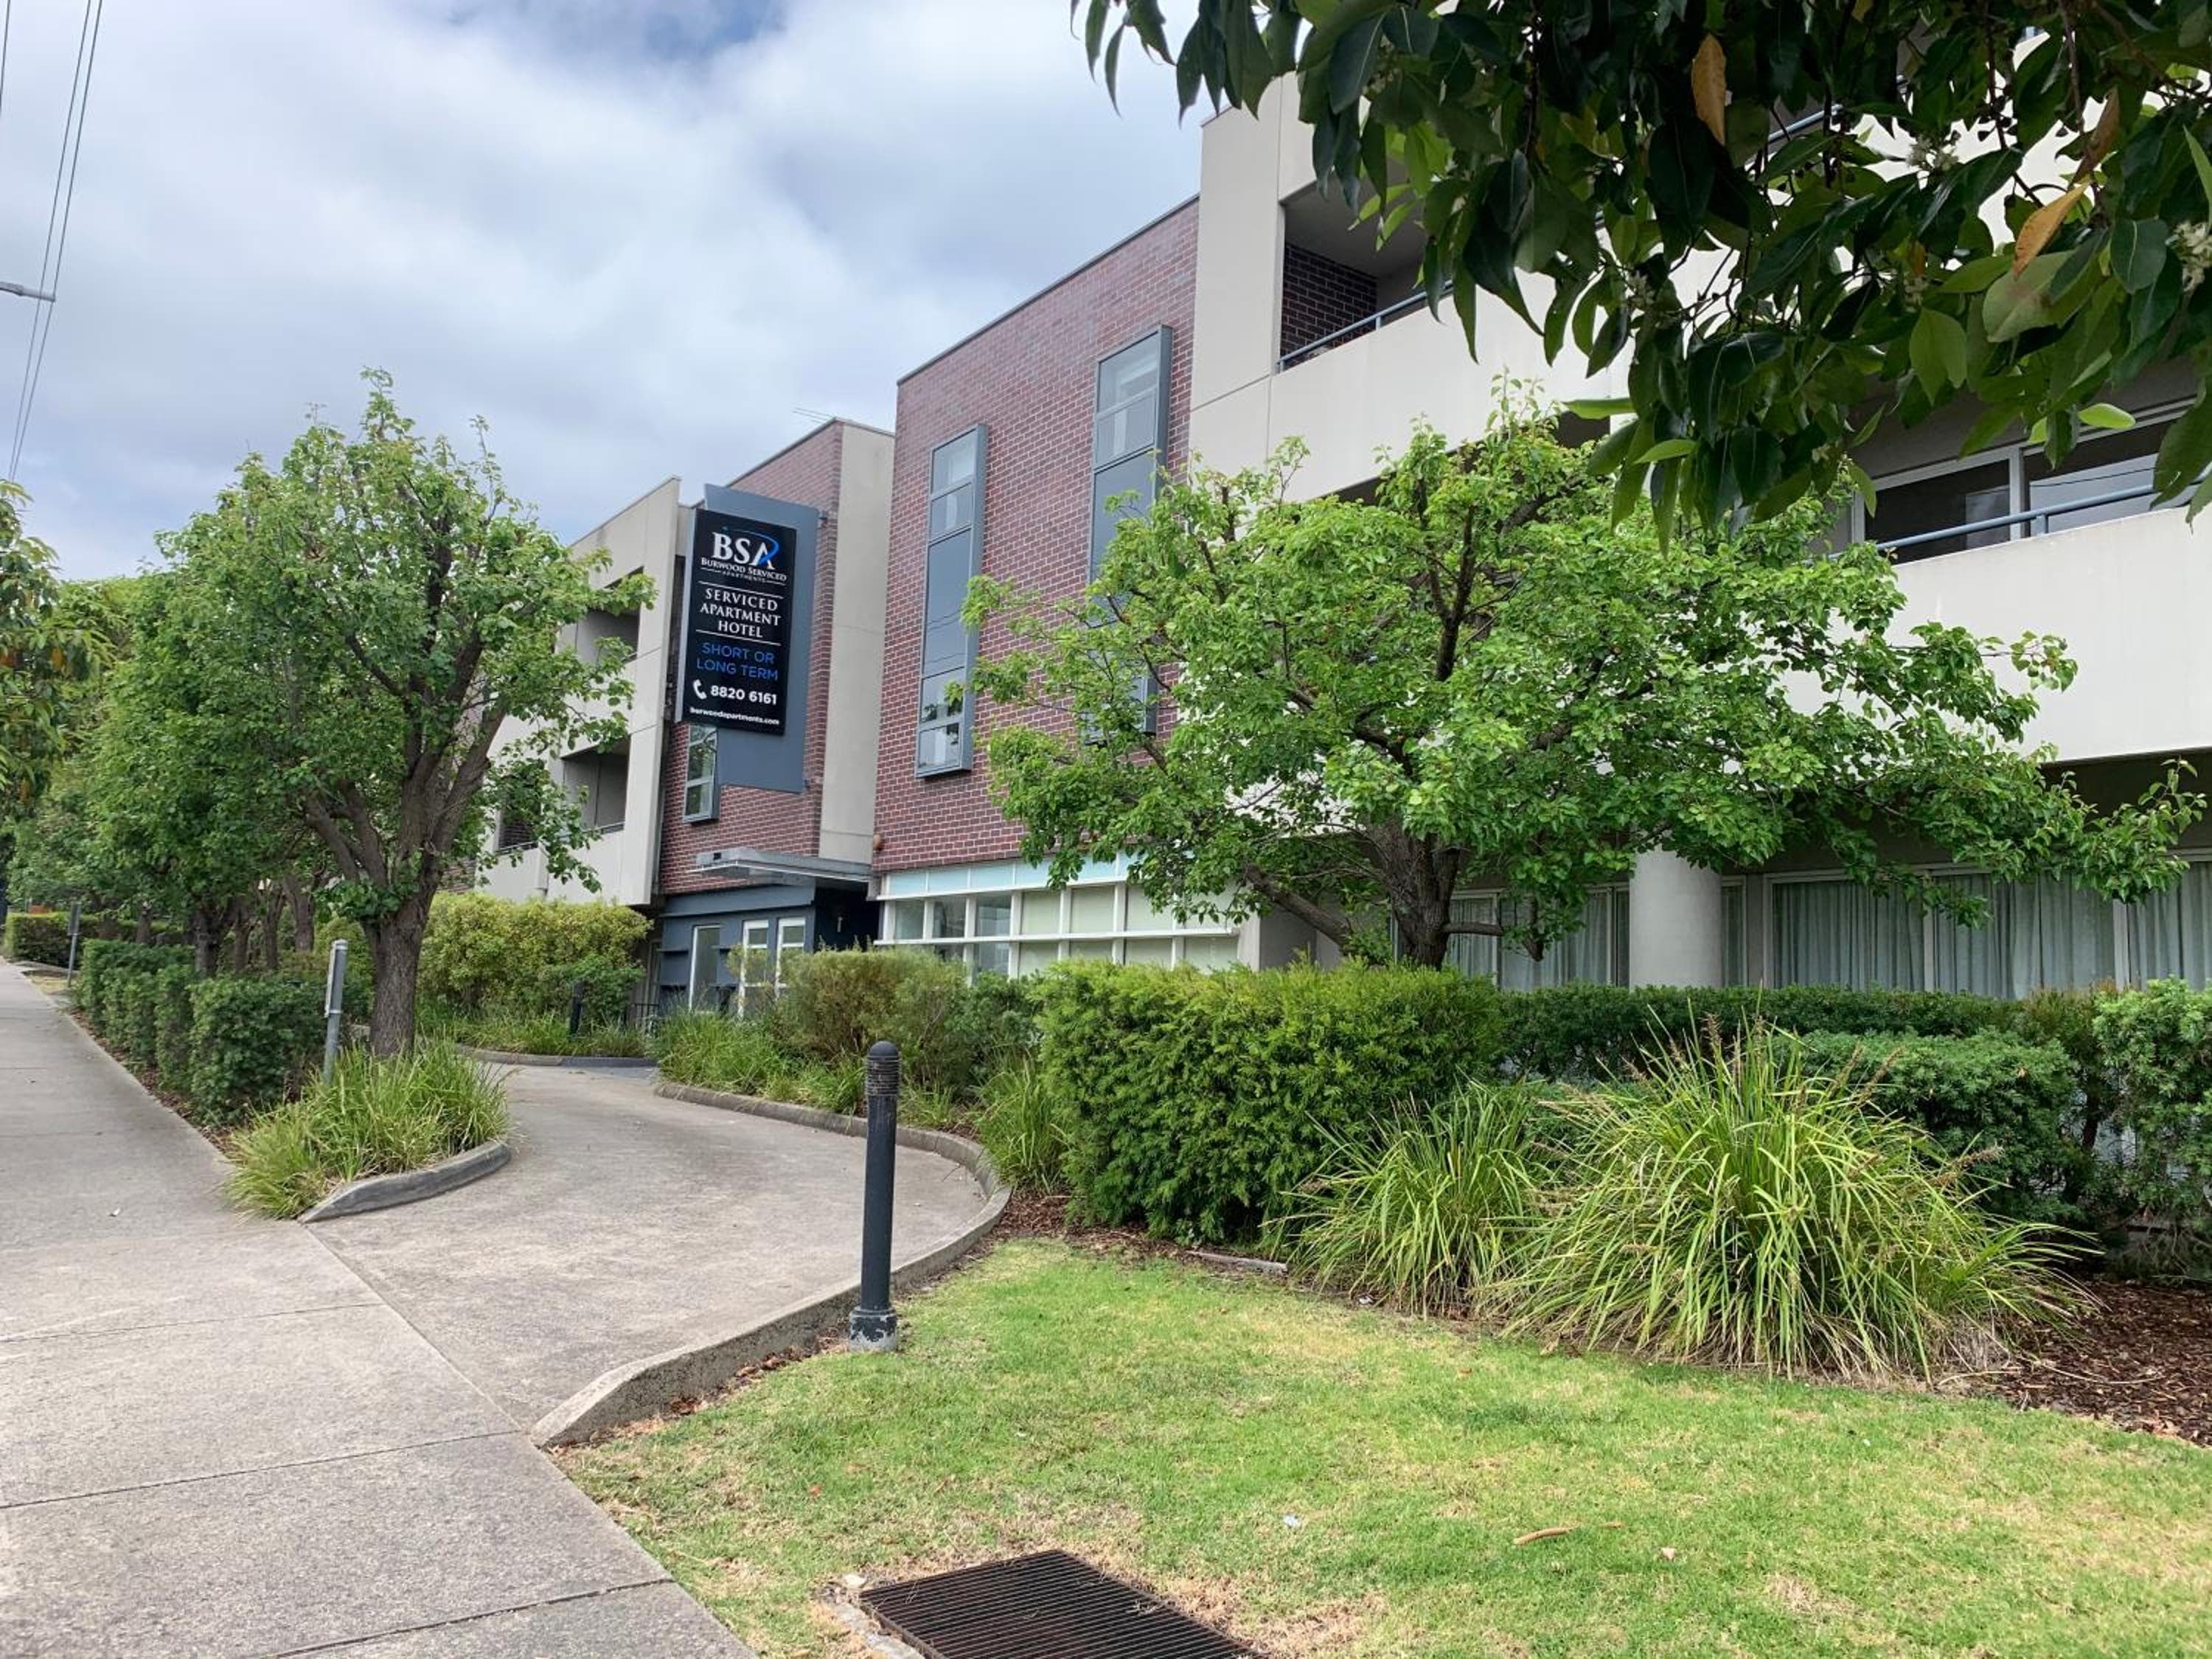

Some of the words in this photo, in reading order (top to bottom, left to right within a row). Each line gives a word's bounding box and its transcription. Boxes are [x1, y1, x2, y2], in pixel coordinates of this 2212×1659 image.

[712, 532, 776, 570] BSA
[701, 557, 745, 573] BURWOOD
[748, 567, 787, 582] SERVICED
[706, 588, 778, 611] SERVICED
[700, 603, 782, 626] APARTMENT
[718, 620, 762, 638] HOTEL
[702, 642, 751, 660] SHORT
[754, 651, 774, 664] OR
[696, 658, 737, 675] LONG
[740, 664, 778, 681] TERM
[710, 685, 745, 700] 8820
[748, 691, 777, 705] 6161
